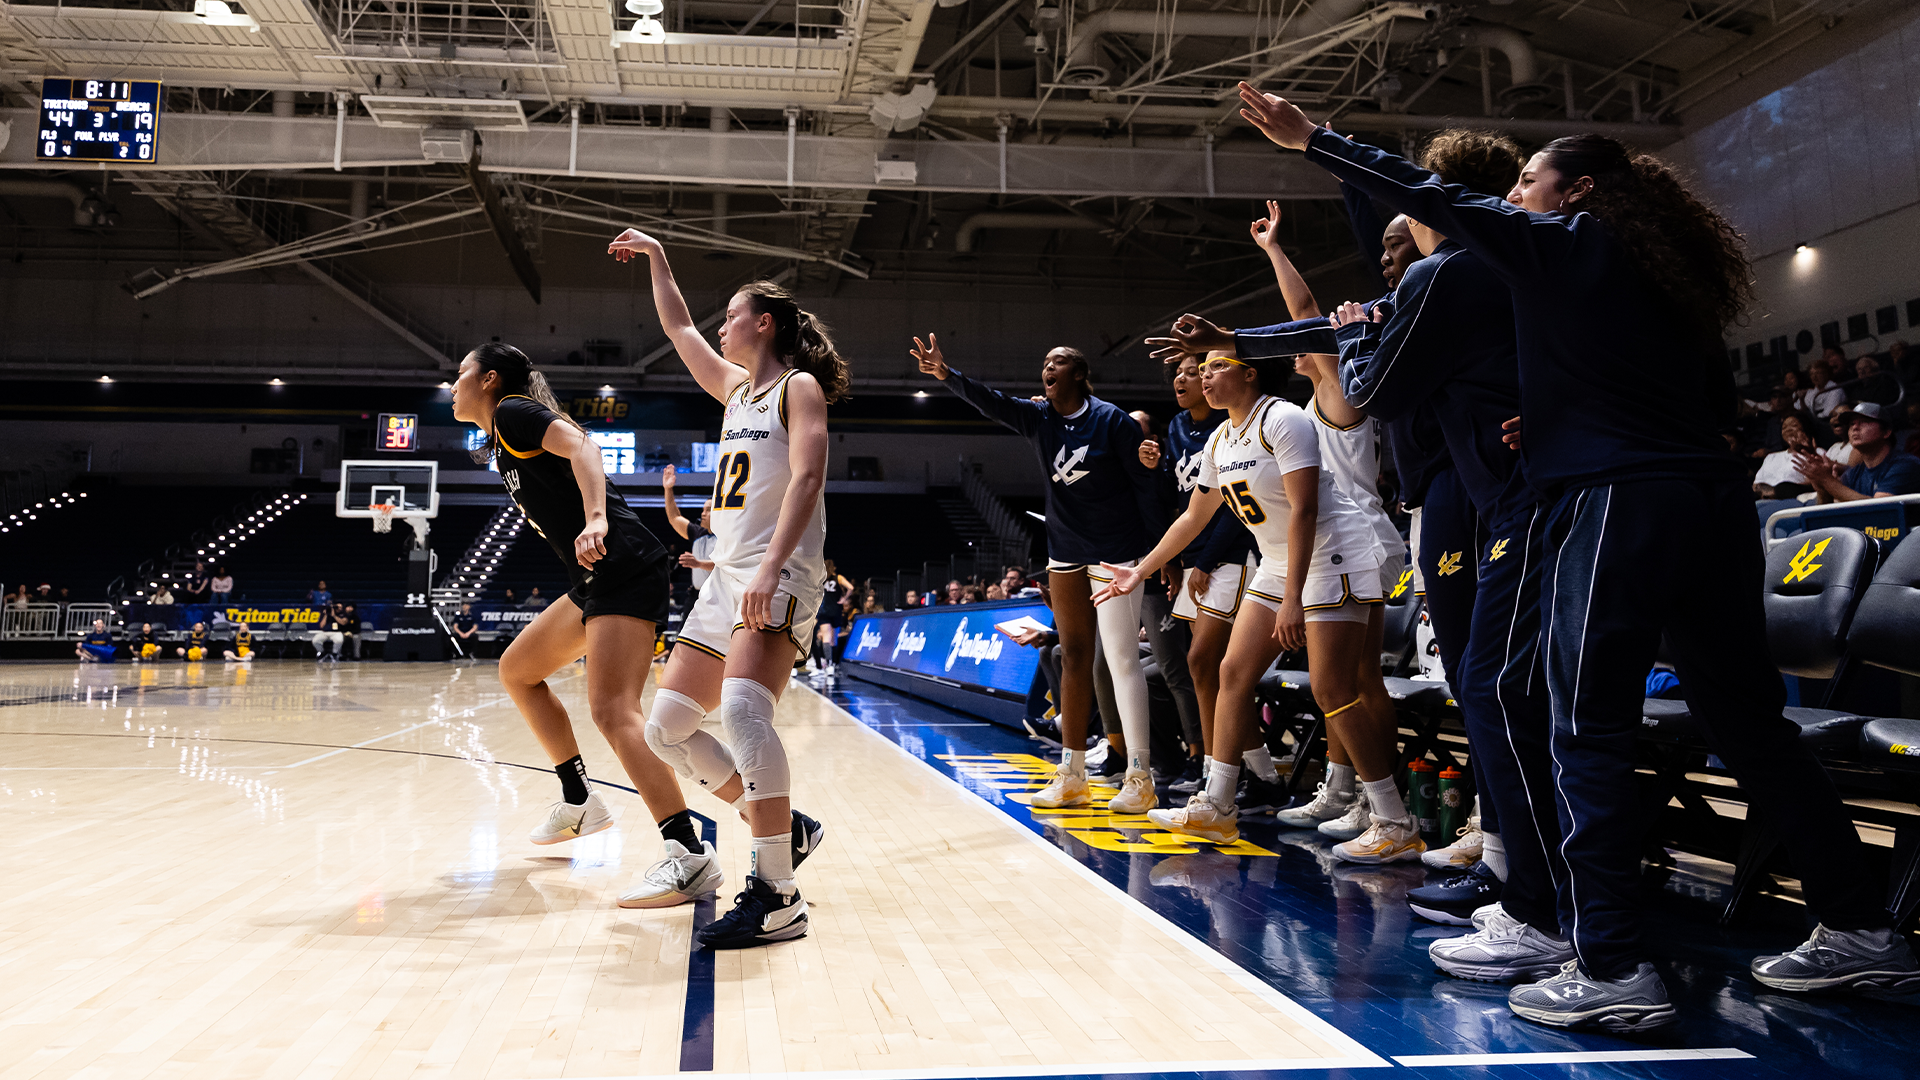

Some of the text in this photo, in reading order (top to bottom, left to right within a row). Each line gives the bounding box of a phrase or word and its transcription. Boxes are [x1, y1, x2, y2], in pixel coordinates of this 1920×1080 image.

[86, 80, 128, 99] 8:11
[43, 99, 88, 110] TRITONS
[116, 101, 150, 112] BEACH
[49, 111, 73, 127] 44
[93, 112, 103, 127] 3
[135, 113, 153, 129] 19
[41, 130, 57, 140] FLS
[74, 131, 119, 142] FOUL PLYR
[135, 133, 151, 142] FLS
[45, 141, 56, 156] 0
[119, 146, 128, 158] 2
[139, 144, 150, 159] 0
[574, 396, 628, 418] Tide
[389, 417, 414, 428] 8:11
[386, 428, 409, 448] 30
[713, 450, 751, 511] 12
[1865, 526, 1899, 541] Diego
[226, 608, 321, 624] Triton Tide
[481, 611, 502, 621] THE
